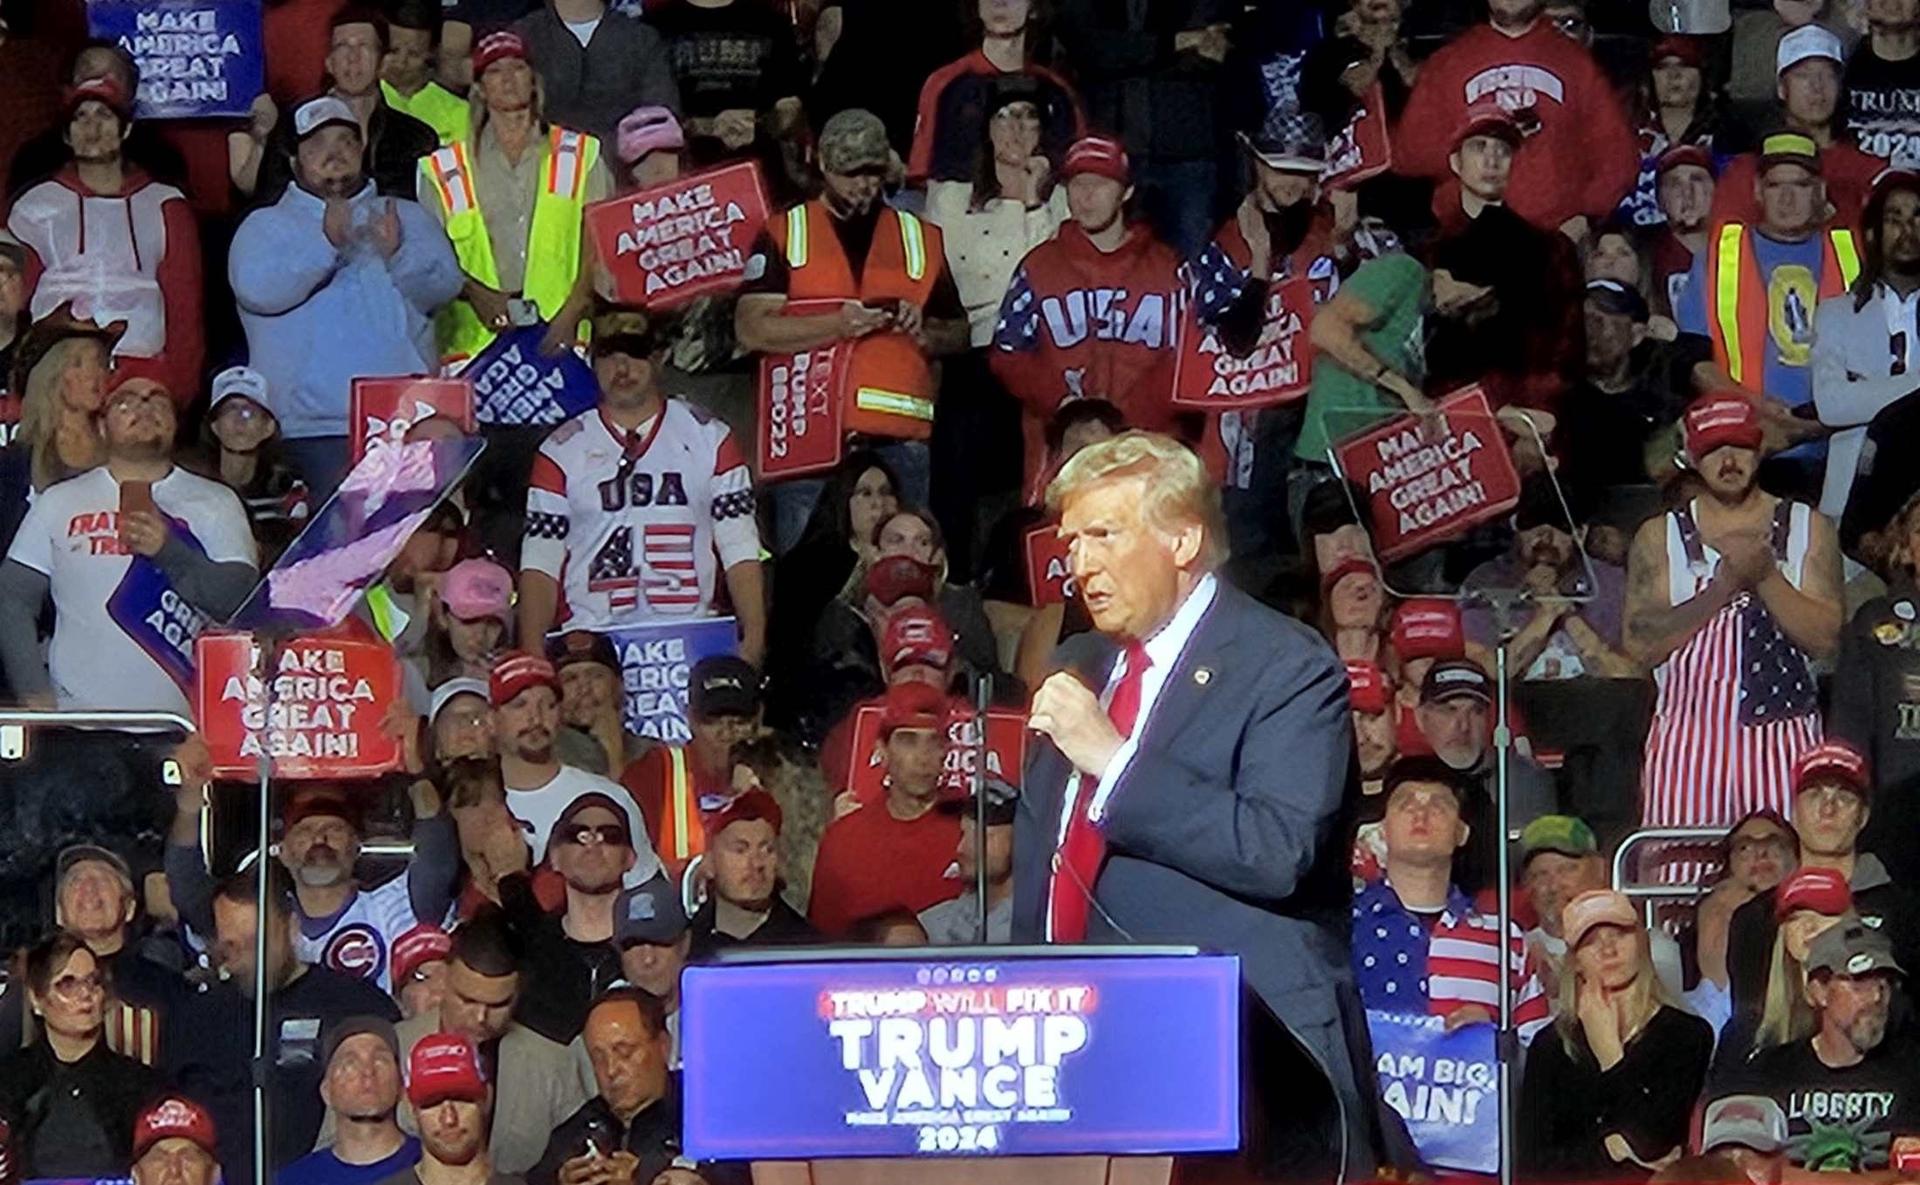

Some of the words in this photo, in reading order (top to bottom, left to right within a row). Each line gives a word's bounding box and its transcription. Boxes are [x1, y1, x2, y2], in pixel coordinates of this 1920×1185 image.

[136, 10, 216, 33] MAKE
[632, 183, 716, 225] MAKE
[616, 202, 746, 257] AMERICA
[638, 226, 734, 272] GREAT
[1041, 288, 1164, 349] USA
[473, 343, 522, 406] AGA
[474, 363, 539, 424] GREA
[791, 352, 812, 436] RUMP
[1369, 431, 1484, 494] AMERICA
[1390, 456, 1473, 511] GREAT
[597, 471, 687, 512] USA
[588, 523, 701, 615] 45
[615, 638, 686, 667] AKE
[622, 663, 691, 693] ERIC
[831, 990, 928, 1018] TRUMP
[930, 989, 1001, 1015] WILL
[1005, 987, 1054, 1013] FIX
[1058, 987, 1088, 1013] IT
[829, 1014, 1088, 1070] TRUMP
[859, 1064, 1057, 1110] VANCE
[1789, 1091, 1894, 1119] LIBERTY
[918, 1124, 999, 1150] 2024
